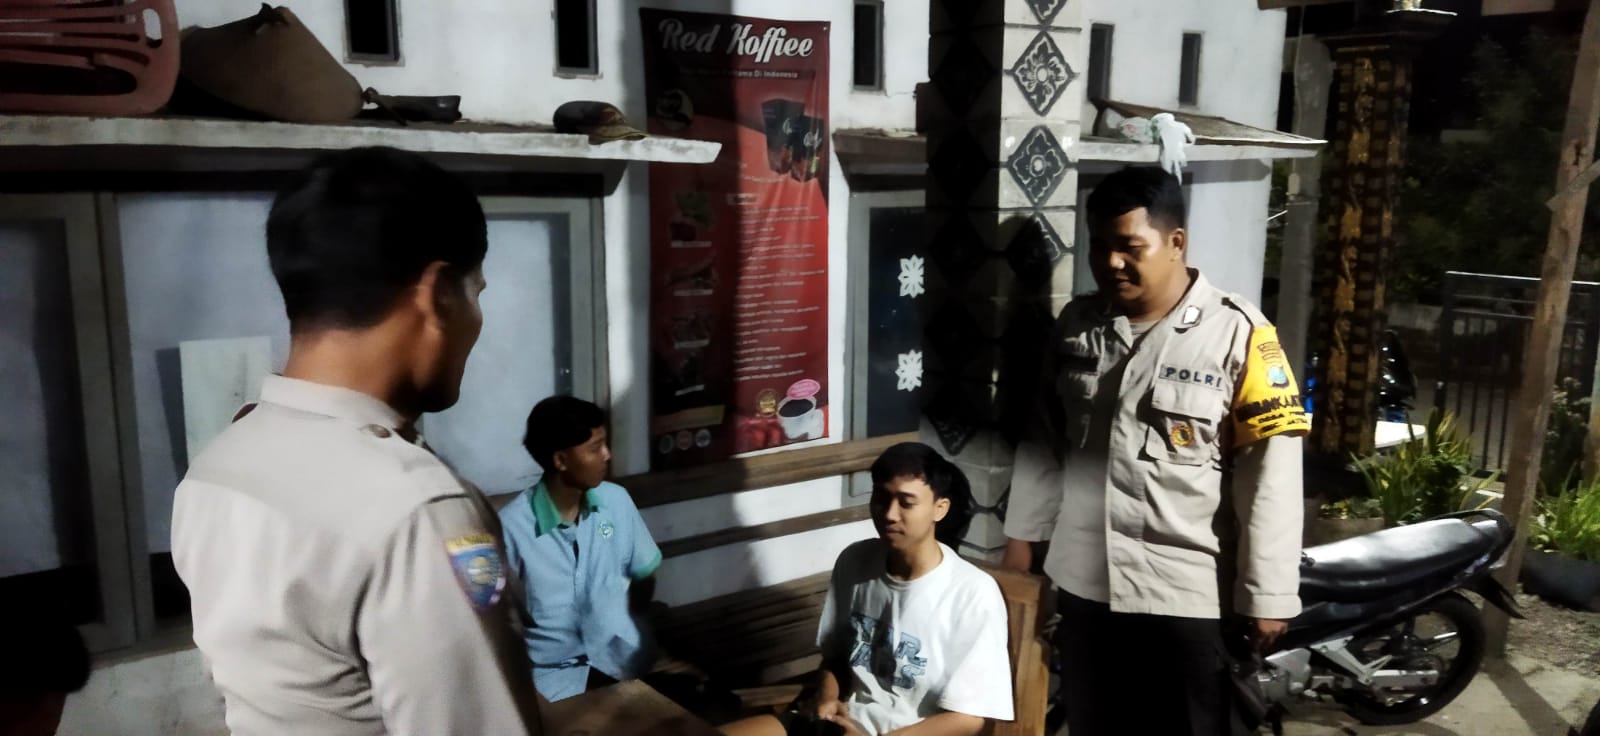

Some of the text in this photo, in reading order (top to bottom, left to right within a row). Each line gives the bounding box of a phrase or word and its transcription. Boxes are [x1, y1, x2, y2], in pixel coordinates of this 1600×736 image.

[659, 18, 814, 63] Red Koffiee
[763, 70, 798, 79] Indonesia
[1165, 367, 1222, 388] POLRI
